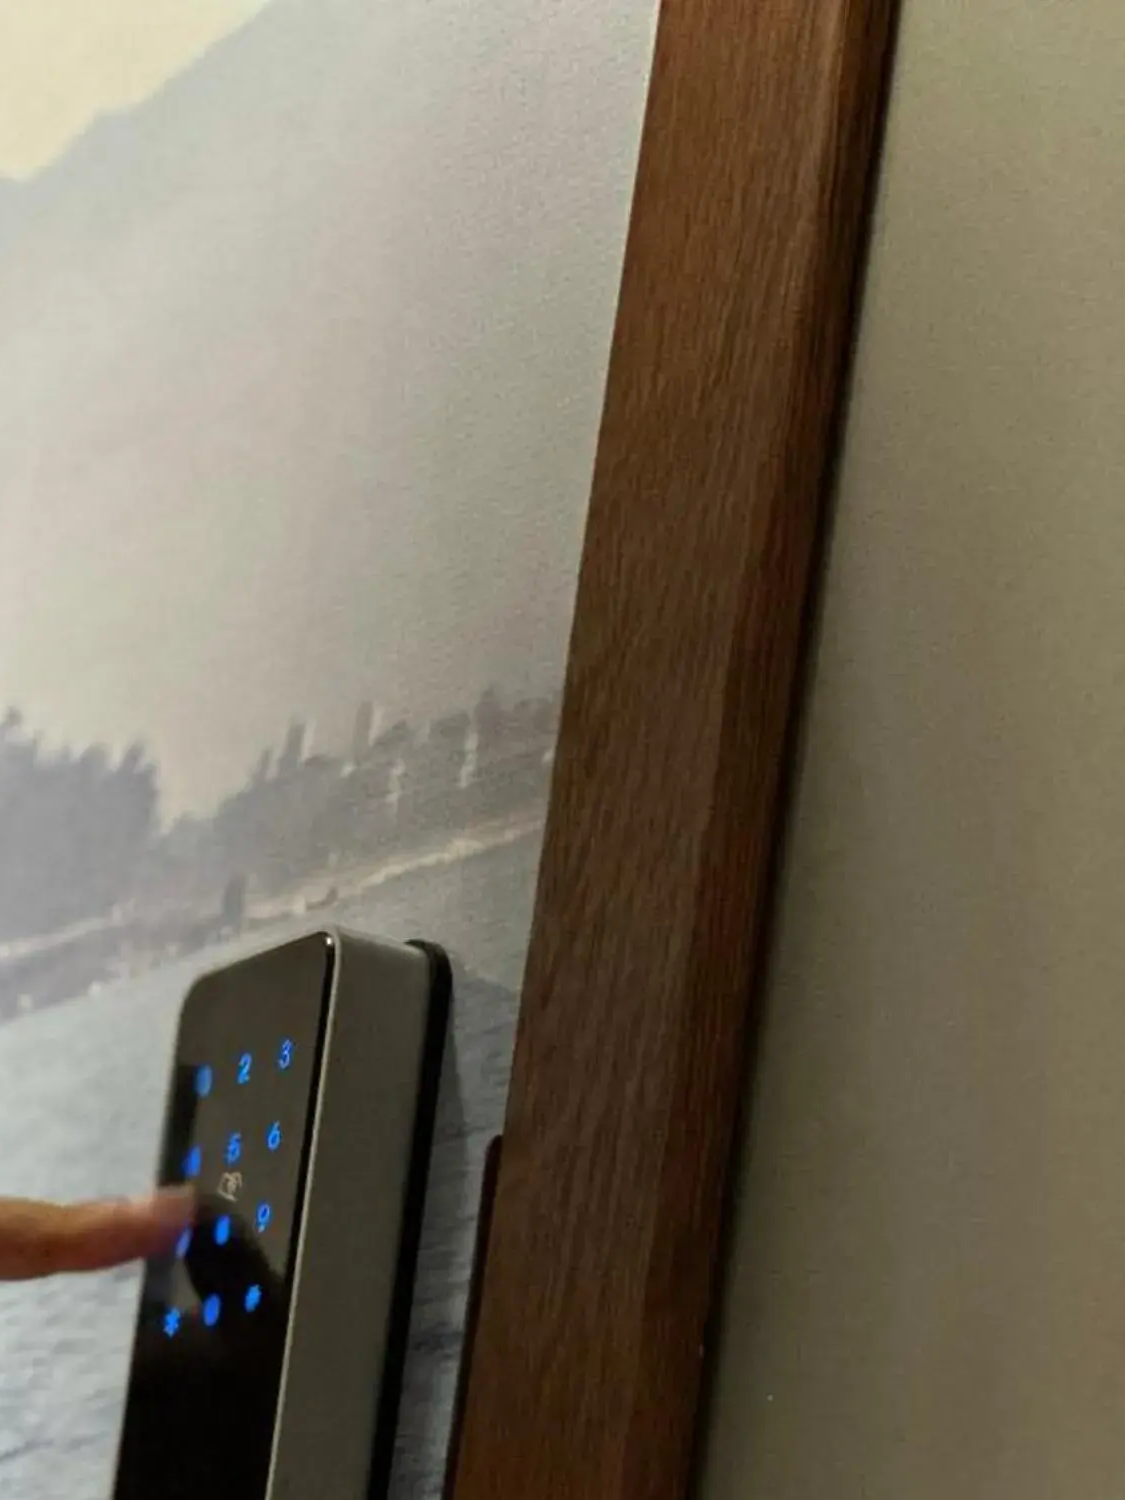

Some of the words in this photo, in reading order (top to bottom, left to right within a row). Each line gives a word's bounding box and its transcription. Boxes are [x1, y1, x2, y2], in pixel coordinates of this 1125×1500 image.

[237, 1052, 252, 1084] 2
[278, 1038, 293, 1069] 3
[266, 1120, 282, 1151] 6
[255, 1200, 271, 1233] 9
